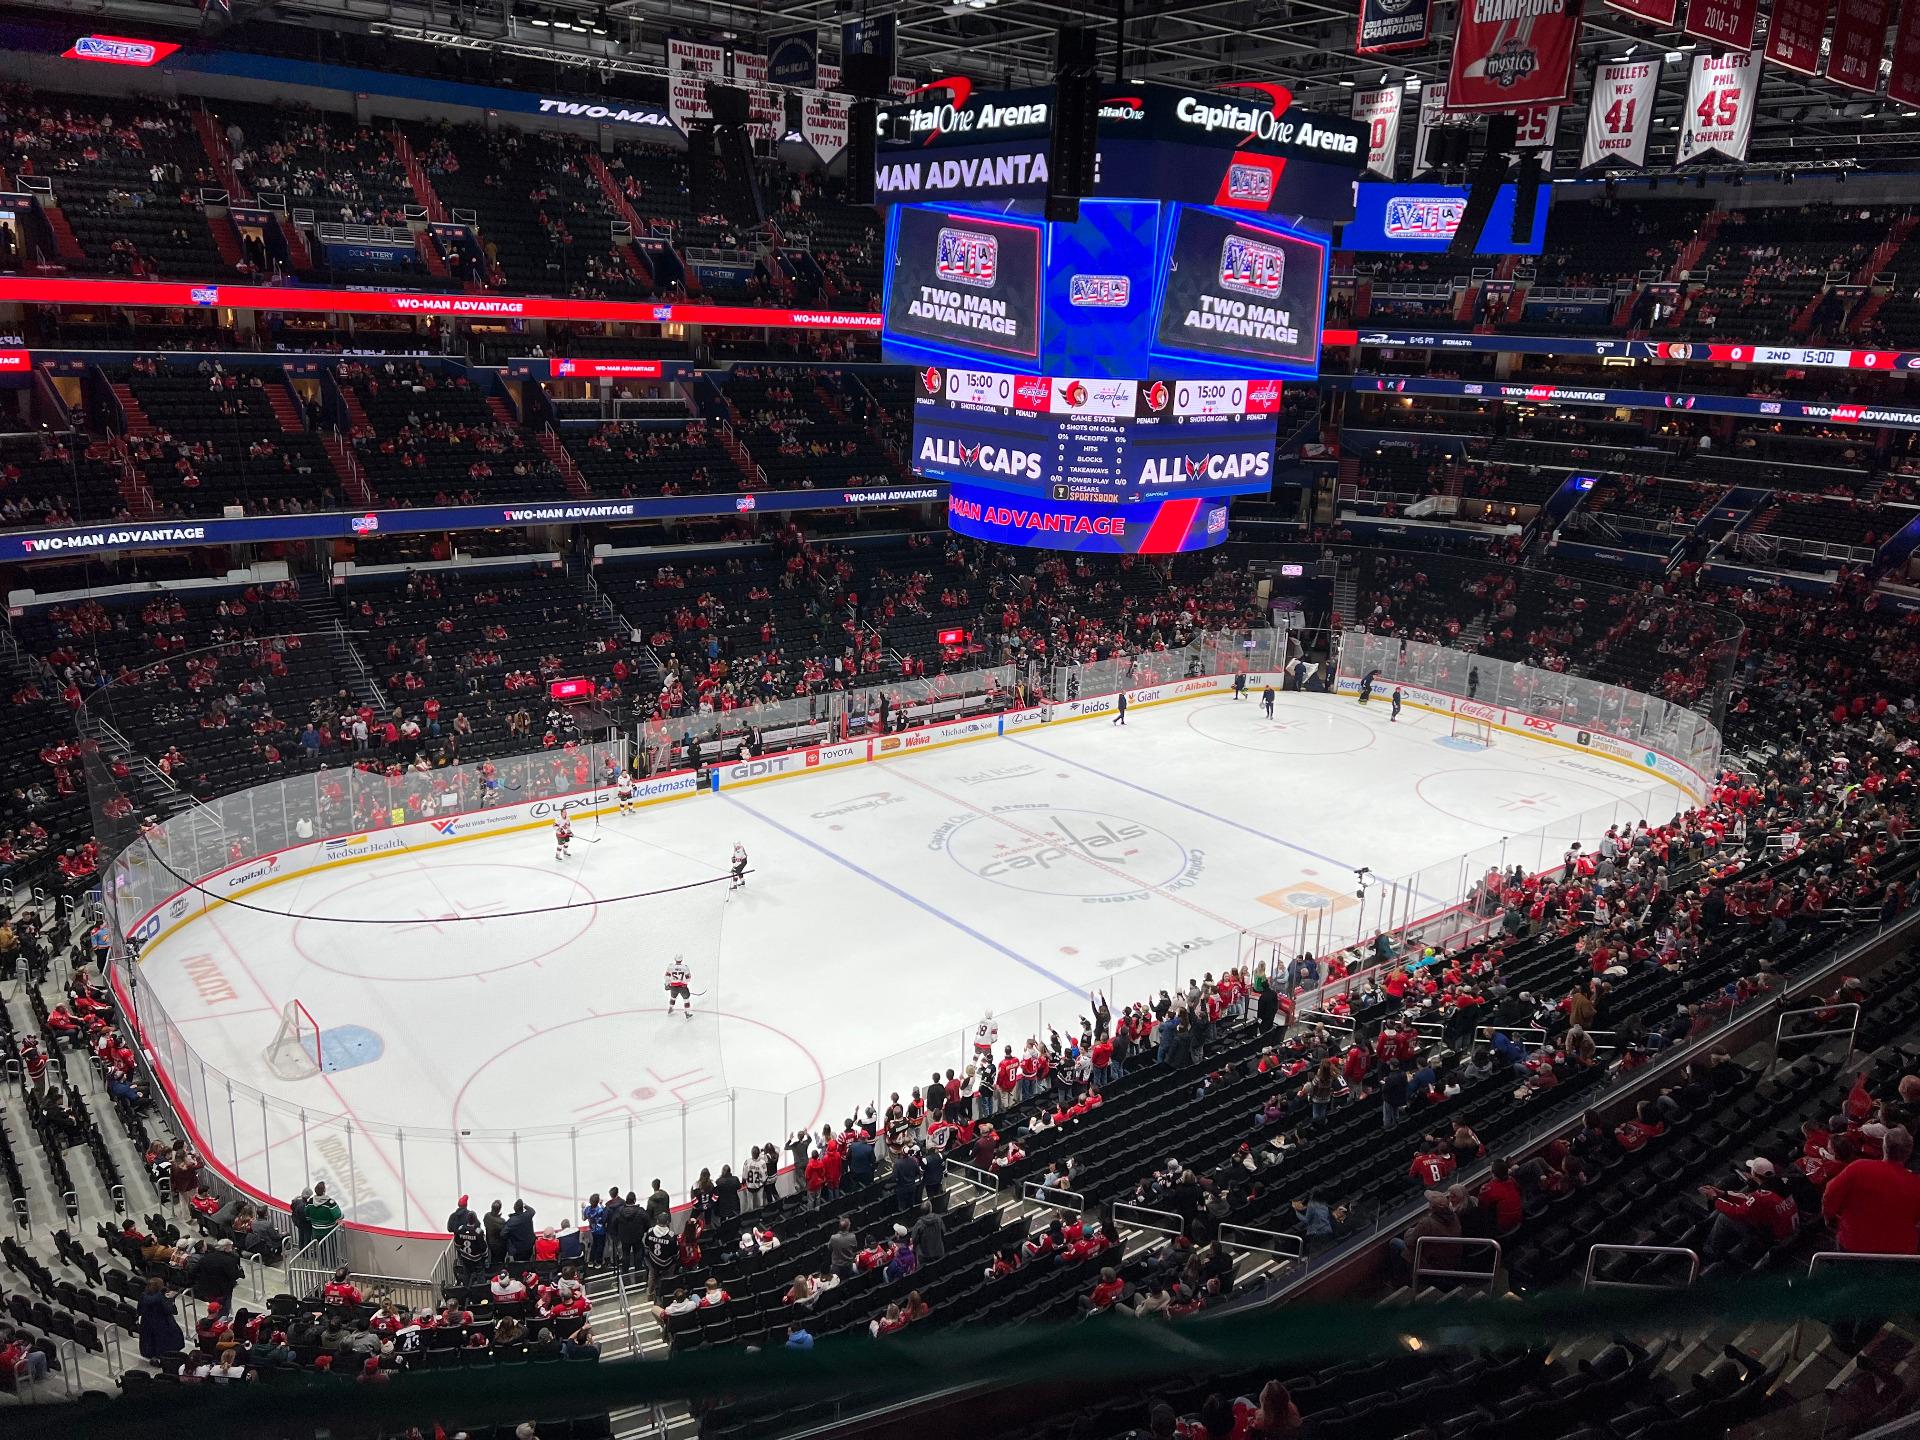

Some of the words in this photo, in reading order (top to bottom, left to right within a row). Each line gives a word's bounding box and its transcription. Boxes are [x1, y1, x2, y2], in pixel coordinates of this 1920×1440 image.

[1381, 16, 1404, 27] ARENA
[1405, 14, 1424, 24] BOWL
[1705, 7, 1738, 35] 2016-17
[1363, 20, 1423, 40] CHAMPIONS
[1703, 54, 1751, 70] BULLETS
[1841, 54, 1868, 79] 2017-18
[1605, 65, 1649, 80] BULLETS
[1713, 74, 1735, 86] PHIL
[1615, 84, 1633, 95] WES
[1360, 91, 1394, 105] BULLETS
[1696, 88, 1741, 127] 45
[876, 103, 973, 136] CitalOne
[977, 103, 1047, 130] Arena
[1604, 98, 1637, 133] 41
[807, 116, 846, 131] CHAMPIONS
[811, 132, 842, 147] 1977-78
[1296, 123, 1358, 153] Arena
[1599, 138, 1632, 150] UNSELD
[1695, 131, 1735, 143] CHENIER
[876, 163, 921, 191] MAN
[944, 237, 993, 277] VIP
[1230, 246, 1278, 288] VIP
[453, 301, 524, 312] ADVANTAGE
[921, 286, 962, 307] TWO
[963, 294, 1006, 317] MAN
[908, 300, 1017, 336] ADVANTAGE
[1201, 294, 1245, 318] TWO
[1247, 304, 1290, 327] MAN
[832, 314, 882, 326] ADVANTAGE
[1184, 310, 1299, 345] ADVANTAGE
[1730, 347, 1742, 360] 0
[1766, 350, 1791, 361] 2ND
[1802, 350, 1835, 364] 15:00
[1864, 349, 1876, 366] 0
[949, 374, 959, 394] 0
[966, 373, 992, 388] 15:00
[999, 379, 1010, 399] 0
[1197, 385, 1226, 399] 15:00
[1231, 386, 1242, 407] 0
[1501, 386, 1546, 397] TWO-MAN
[1547, 389, 1606, 401] ADVANTAGE
[916, 397, 936, 406] PENALTY
[1178, 387, 1190, 408] 0
[950, 400, 956, 409] 0
[960, 402, 976, 411] SHOTS
[984, 405, 997, 413] GOAL
[1003, 407, 1009, 415] 0
[1015, 409, 1037, 419] PENALTY
[1802, 406, 1857, 418] TWO-MAN
[1070, 414, 1092, 422] GAME
[1093, 415, 1116, 423] STATS
[1136, 417, 1160, 425] PENALTY
[1178, 415, 1184, 425] 0
[1234, 413, 1240, 422] 0
[1246, 413, 1268, 421] PENALTY
[1066, 423, 1088, 432] SHOTS
[1100, 425, 1118, 433] GOAL
[1075, 434, 1109, 442] FACEOFFS
[1115, 436, 1126, 444] 0%
[1117, 446, 1123, 454] 0
[920, 437, 960, 466] ALL
[979, 445, 1042, 479] CAPS
[1069, 466, 1109, 474] TAKEAWAYS
[1138, 457, 1187, 485] ALL
[1207, 451, 1270, 480] CAPS
[1050, 474, 1062, 482] 0/0
[1067, 476, 1092, 484] POWER
[1093, 477, 1110, 485] PLAY
[843, 492, 886, 503] TWO-MAN
[887, 489, 938, 500] ADVANTAGE
[1070, 485, 1100, 493] CAESARS
[1069, 491, 1119, 503] SPORTSBOOK
[504, 508, 563, 521] TWO-MAN
[565, 504, 634, 518] ADVANTAGE
[984, 506, 1126, 536] ADVANTAGE
[23, 535, 105, 552] TWO-MAN
[107, 527, 205, 544] ADVANTAGE
[1184, 680, 1218, 692] Alibaba
[1337, 680, 1387, 694] cketmster
[1137, 690, 1160, 703] Giant
[1081, 700, 1110, 714] leidos
[940, 725, 968, 737] Michael
[980, 722, 992, 730] Son
[1524, 717, 1557, 732] DEX
[905, 735, 931, 748] Wawa
[1592, 734, 1618, 745] CAESARS
[822, 748, 853, 760] TOYOTA
[1590, 740, 1633, 760] SPORTSBOOK
[730, 757, 789, 780] GDIT
[1557, 759, 1639, 783] verizon
[552, 794, 609, 811] LEXUS
[454, 821, 470, 831] World
[471, 819, 484, 828] Wide
[484, 813, 518, 828] Technology
[929, 821, 953, 851] Capital
[954, 811, 977, 826] One
[991, 802, 1050, 813] Arena
[326, 844, 369, 861] MedStar
[370, 839, 403, 854] Health
[1188, 848, 1206, 880] Capital
[1081, 891, 1151, 904] Arena
[1430, 1164, 1440, 1182] 8
[464, 1240, 472, 1255] 8
[653, 1243, 662, 1257] 8
